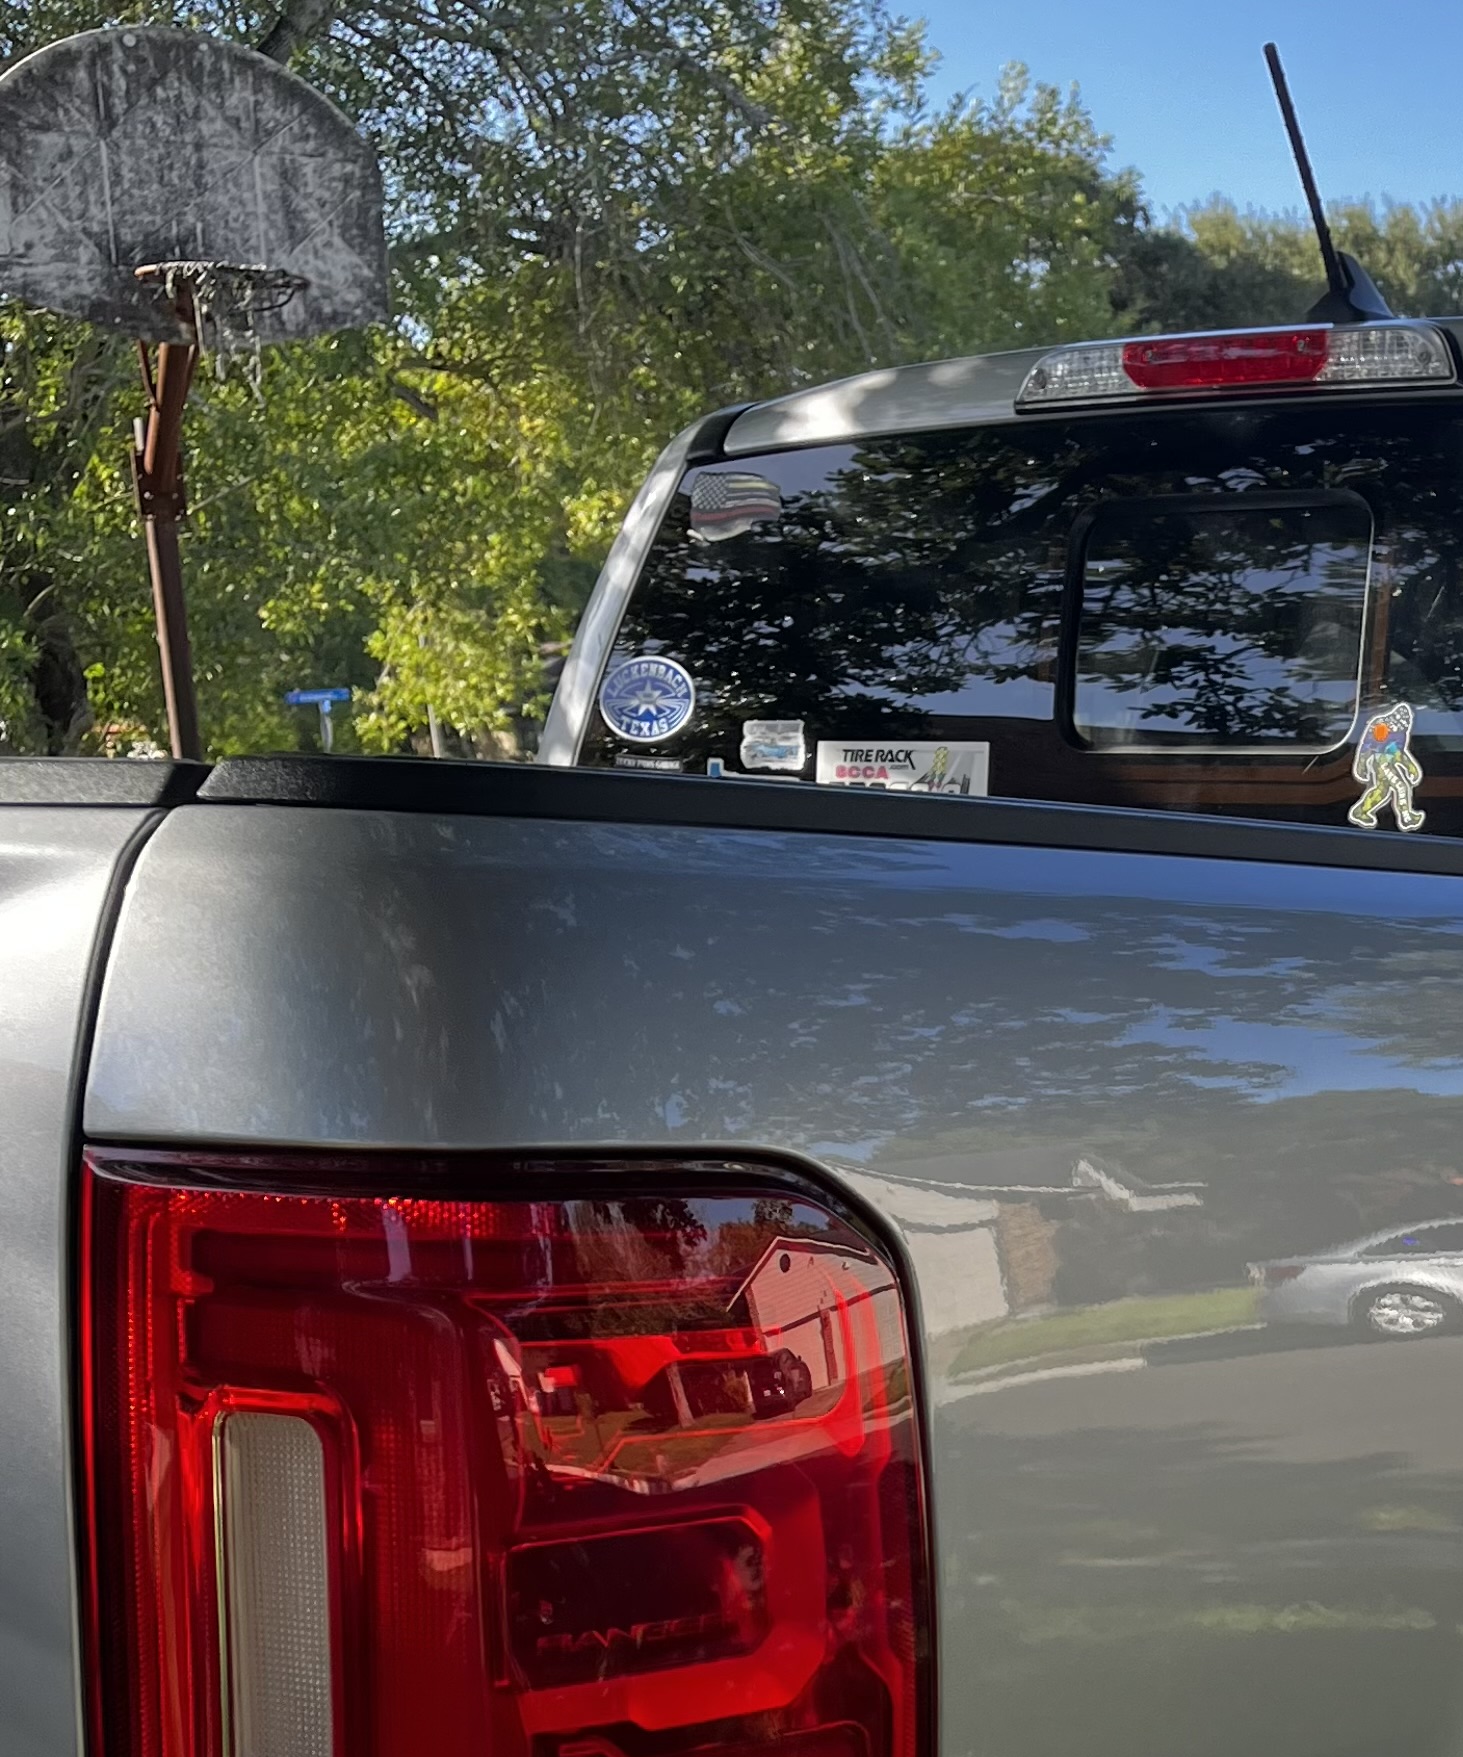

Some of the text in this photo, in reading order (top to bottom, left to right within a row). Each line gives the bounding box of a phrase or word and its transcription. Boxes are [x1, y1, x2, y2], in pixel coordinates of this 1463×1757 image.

[606, 662, 689, 699] LUCKENBACH
[620, 715, 669, 737] TEXAS
[842, 749, 916, 771] TIRE RACK
